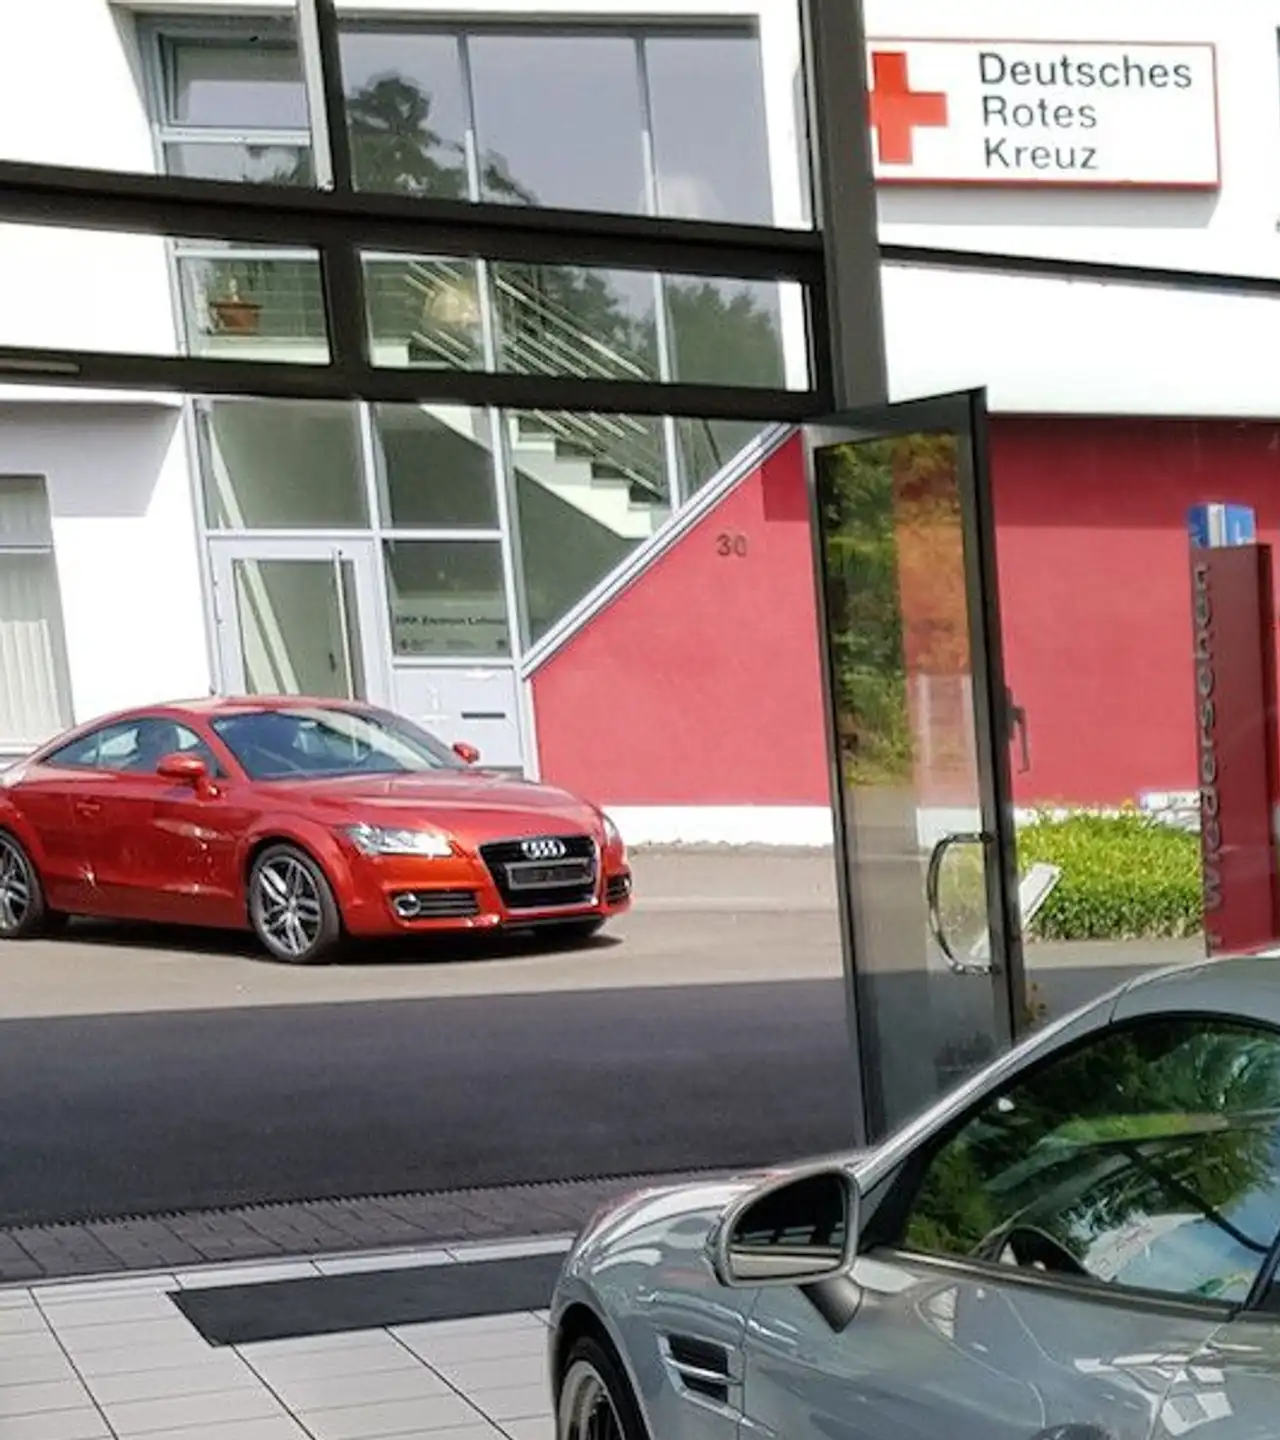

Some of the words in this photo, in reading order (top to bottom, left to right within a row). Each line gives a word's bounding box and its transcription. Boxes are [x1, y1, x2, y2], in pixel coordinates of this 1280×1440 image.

[977, 51, 1193, 89] Deutsches
[981, 95, 1098, 129] Rotes
[983, 136, 1099, 170] Kreuz
[715, 532, 748, 558] 30
